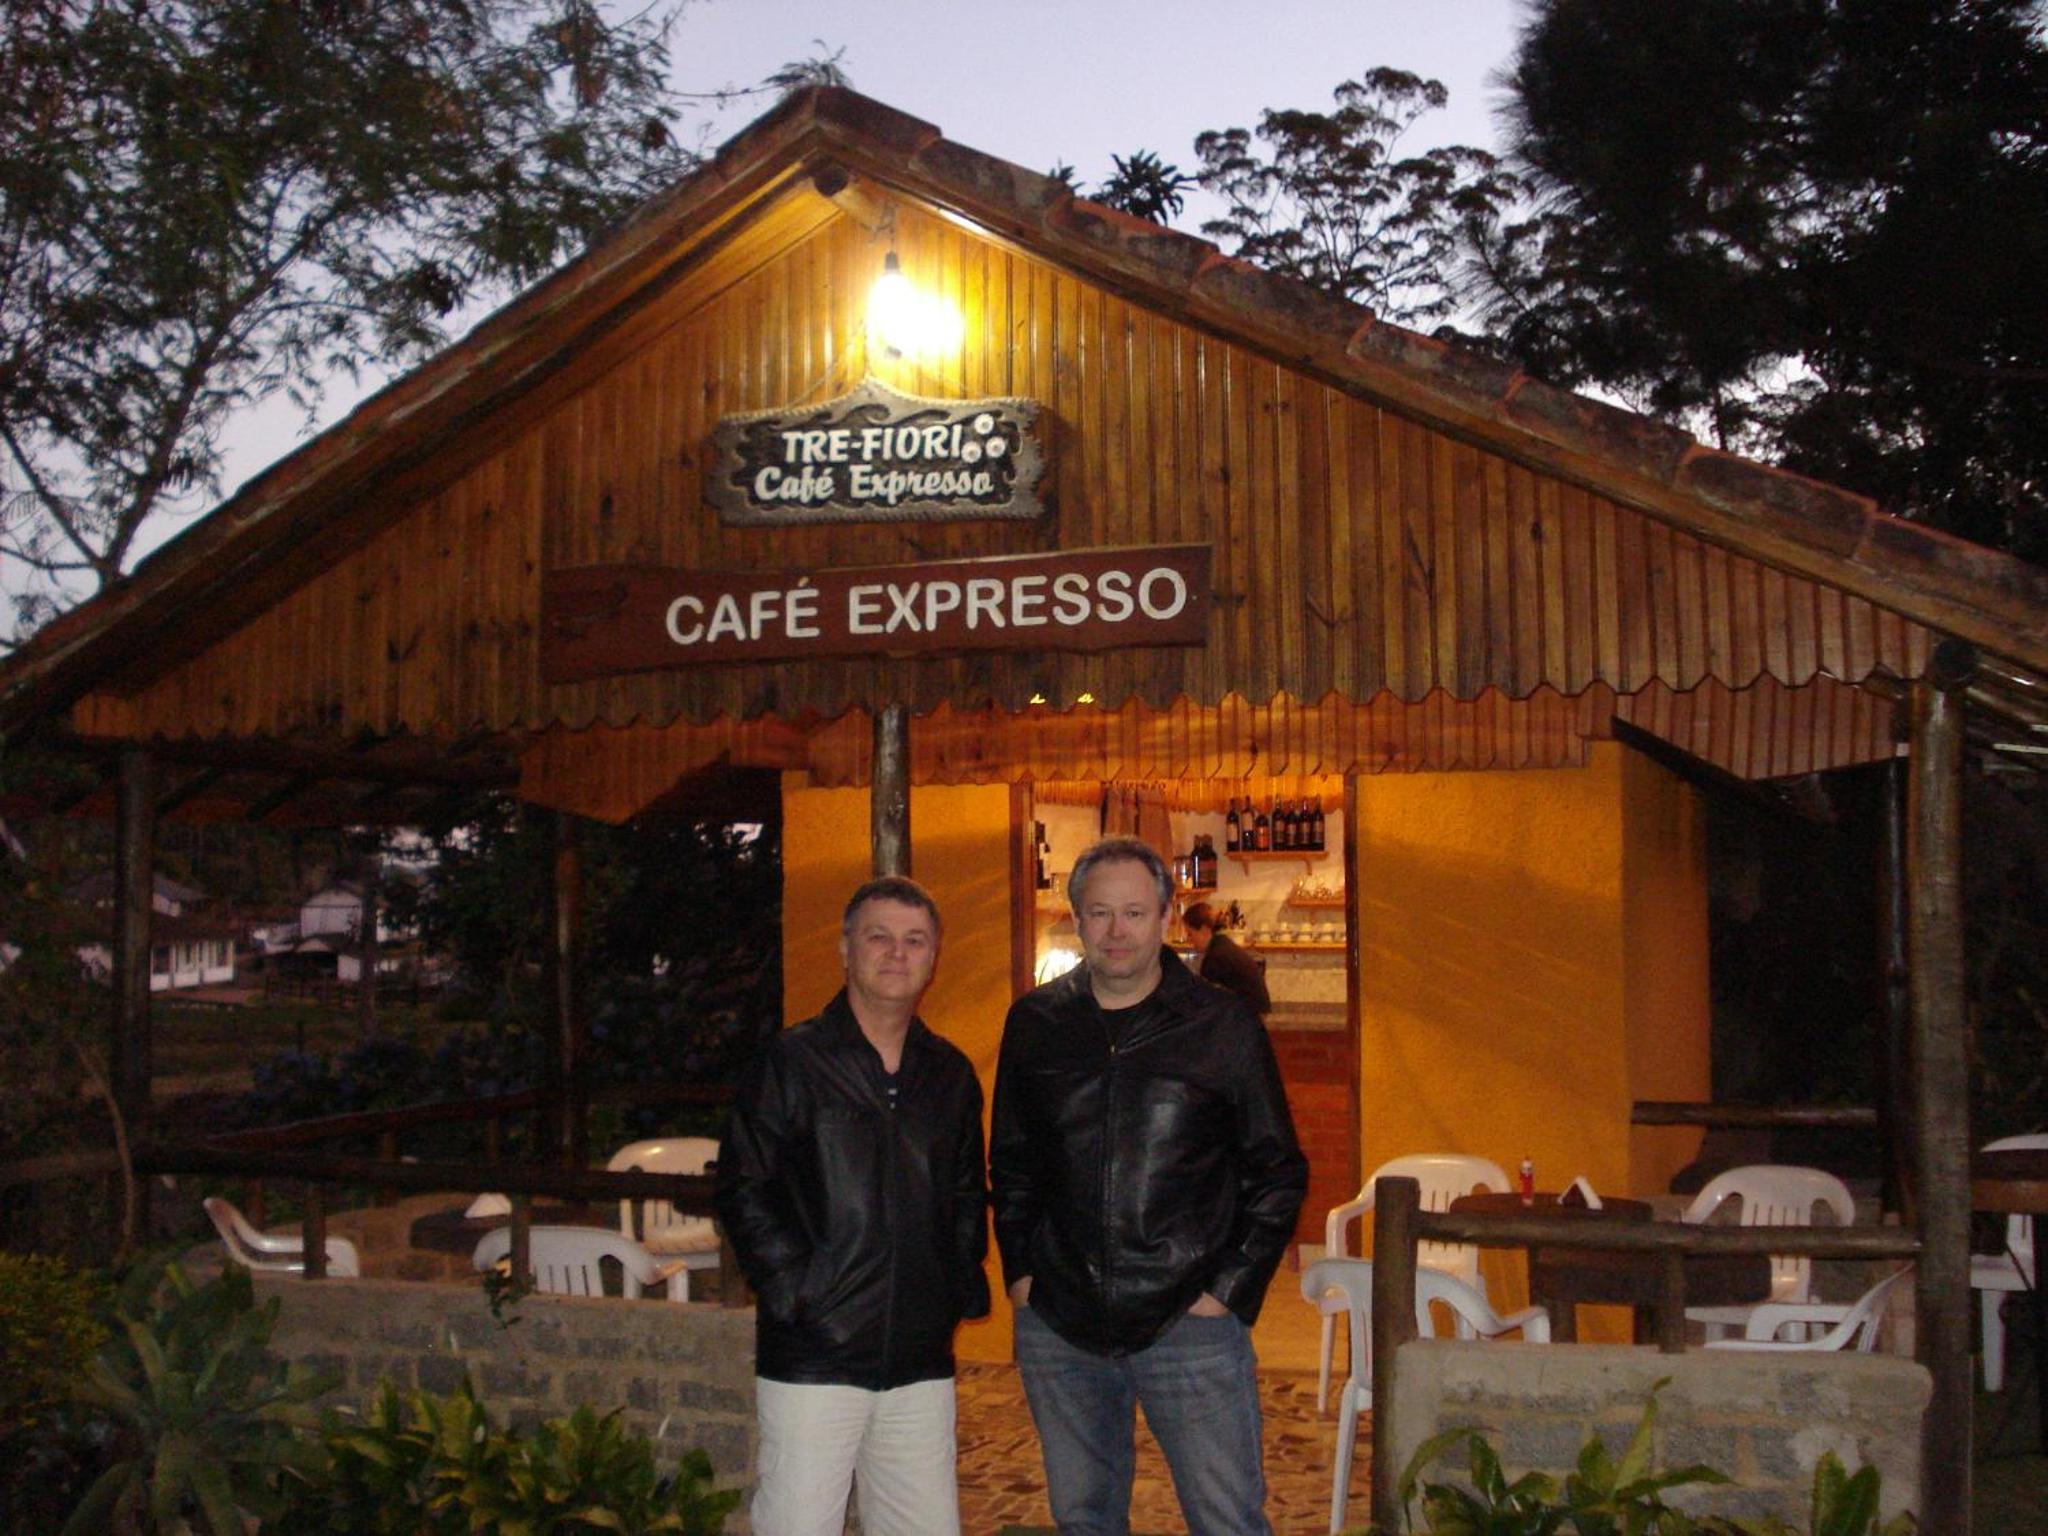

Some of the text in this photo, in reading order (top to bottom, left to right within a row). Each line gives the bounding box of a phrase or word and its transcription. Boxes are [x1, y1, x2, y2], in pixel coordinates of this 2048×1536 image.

[782, 424, 962, 464] TRE-FIORI
[755, 465, 994, 505] Café Expresso
[665, 567, 1188, 646] CAFÉ EXPRESSO
